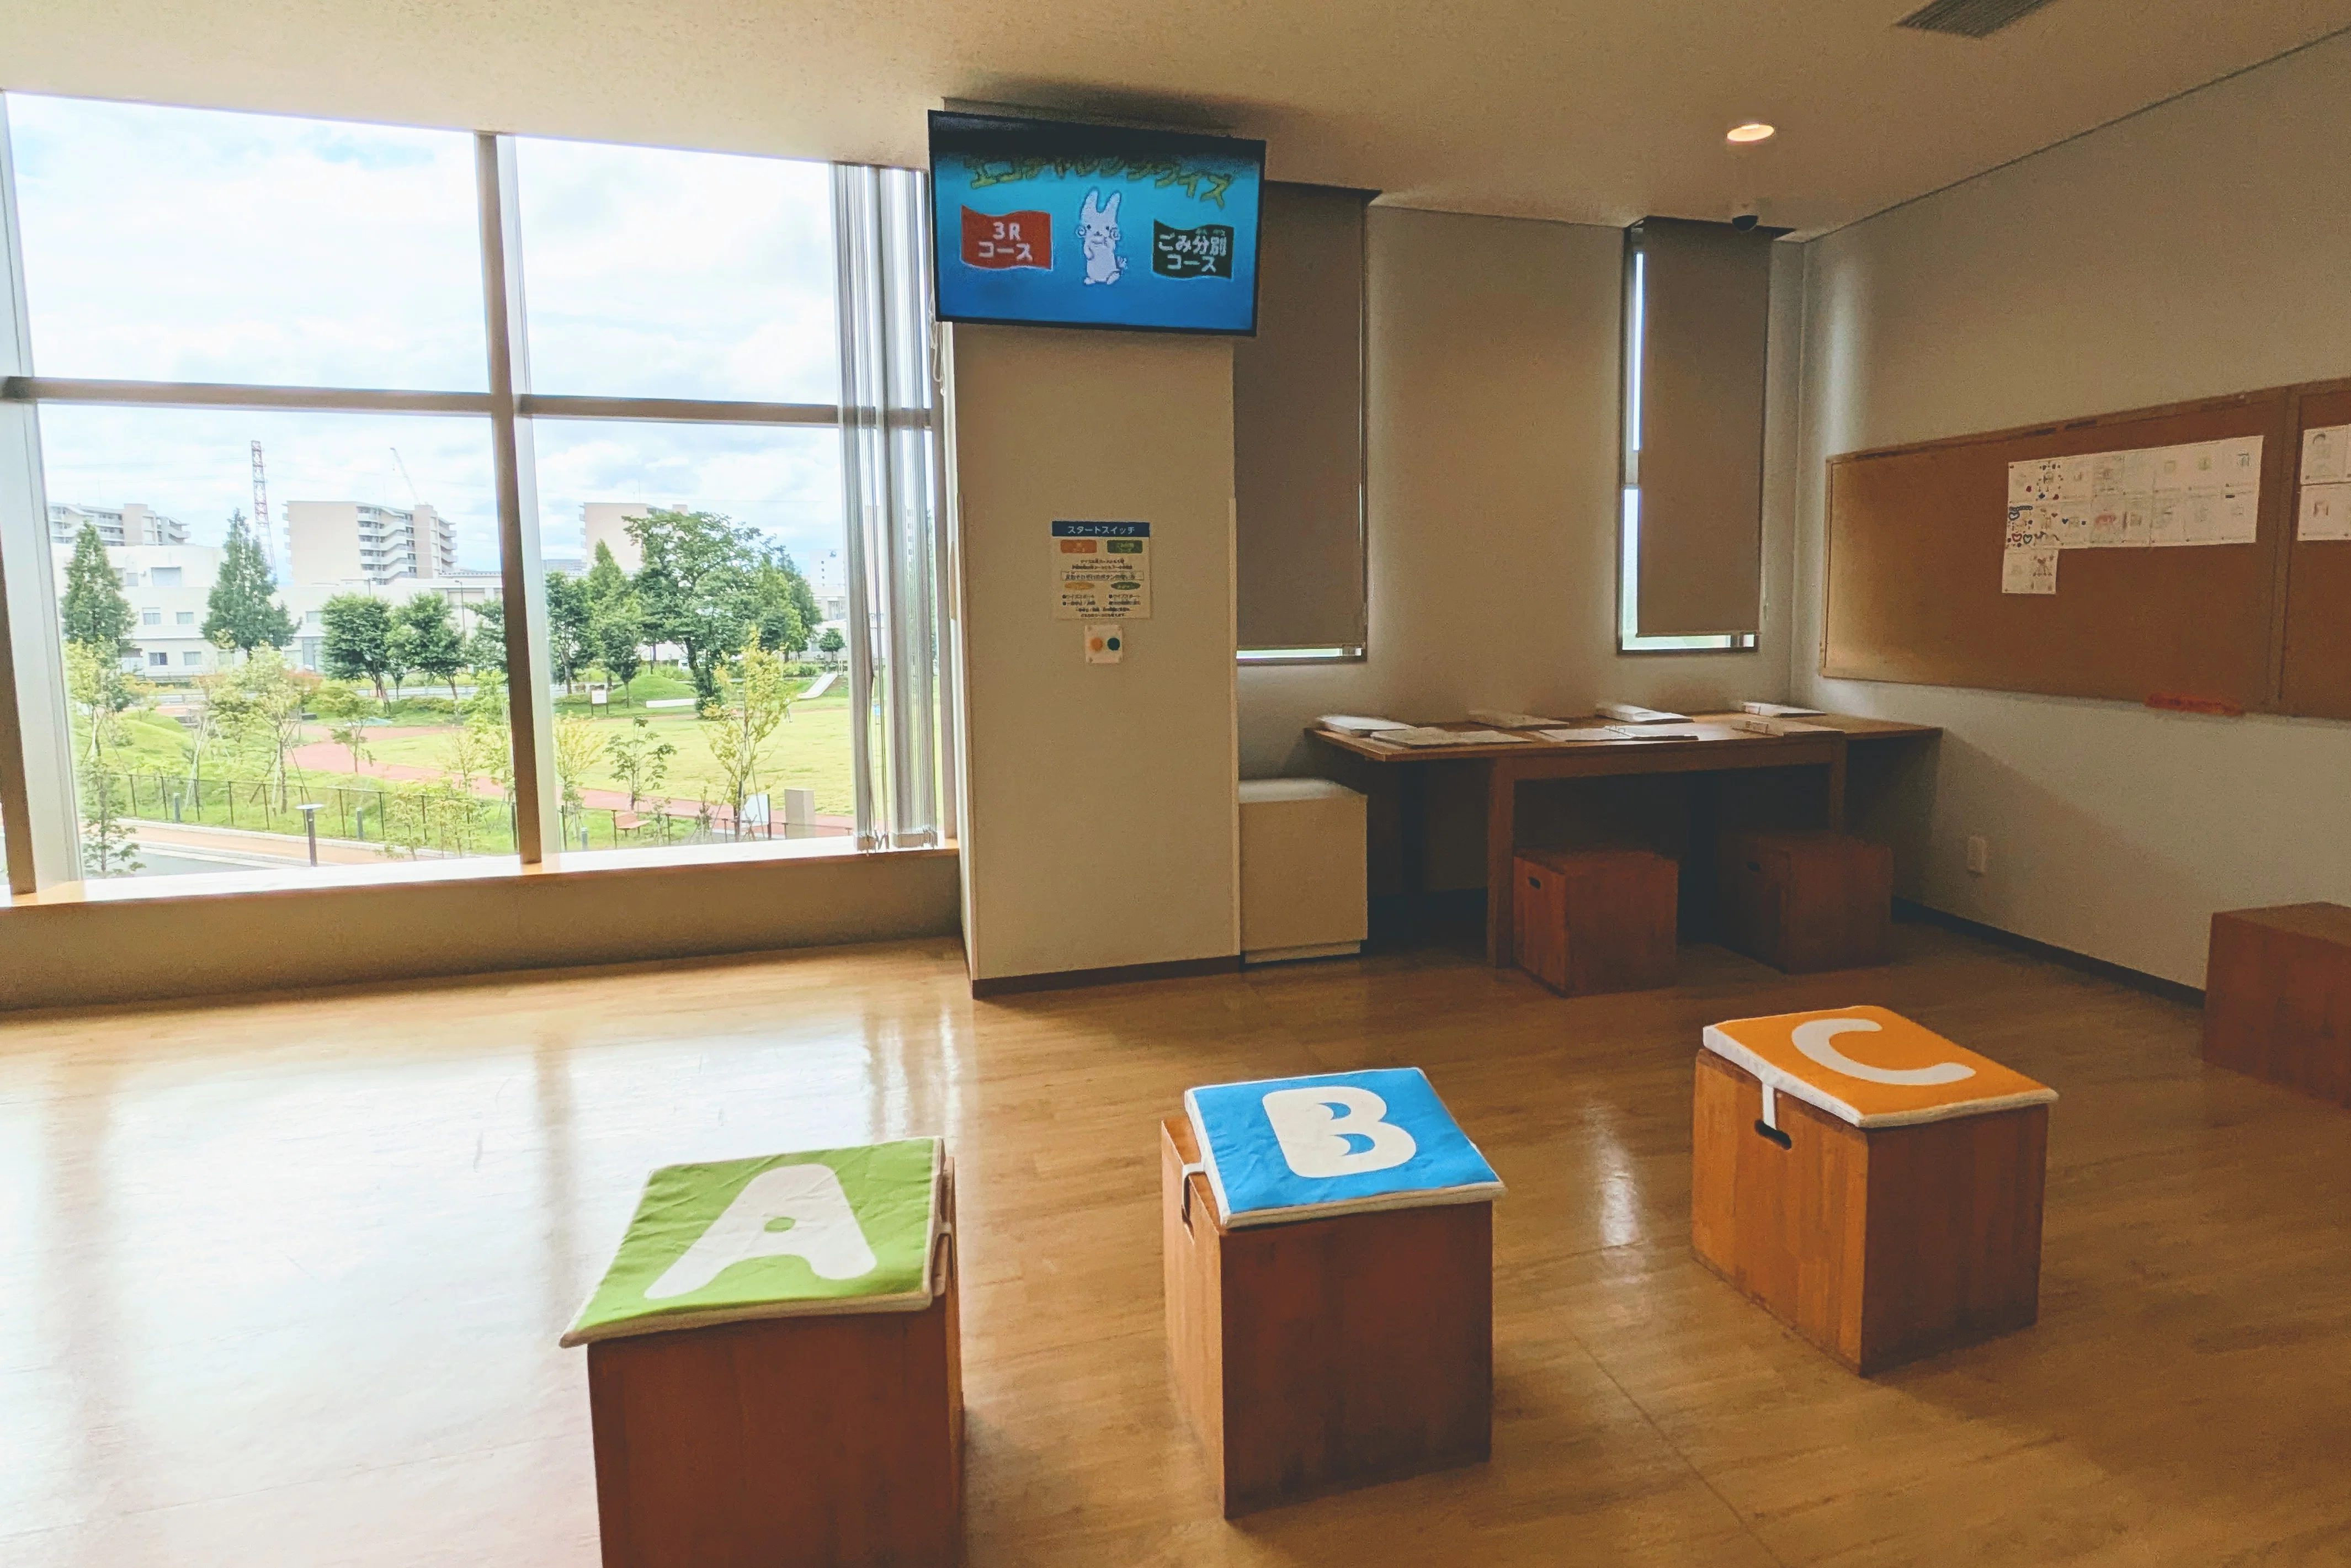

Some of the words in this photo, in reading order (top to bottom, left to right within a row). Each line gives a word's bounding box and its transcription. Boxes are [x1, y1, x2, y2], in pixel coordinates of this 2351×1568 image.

[993, 222, 1021, 241] 3R
[978, 242, 1033, 261] コース
[1158, 232, 1227, 256] ごみ分別
[1167, 254, 1217, 273] コース
[1067, 526, 1135, 535] スタートスイッチ
[1791, 1018, 1977, 1086] C
[1262, 1086, 1417, 1178] B
[644, 1164, 877, 1299] A
